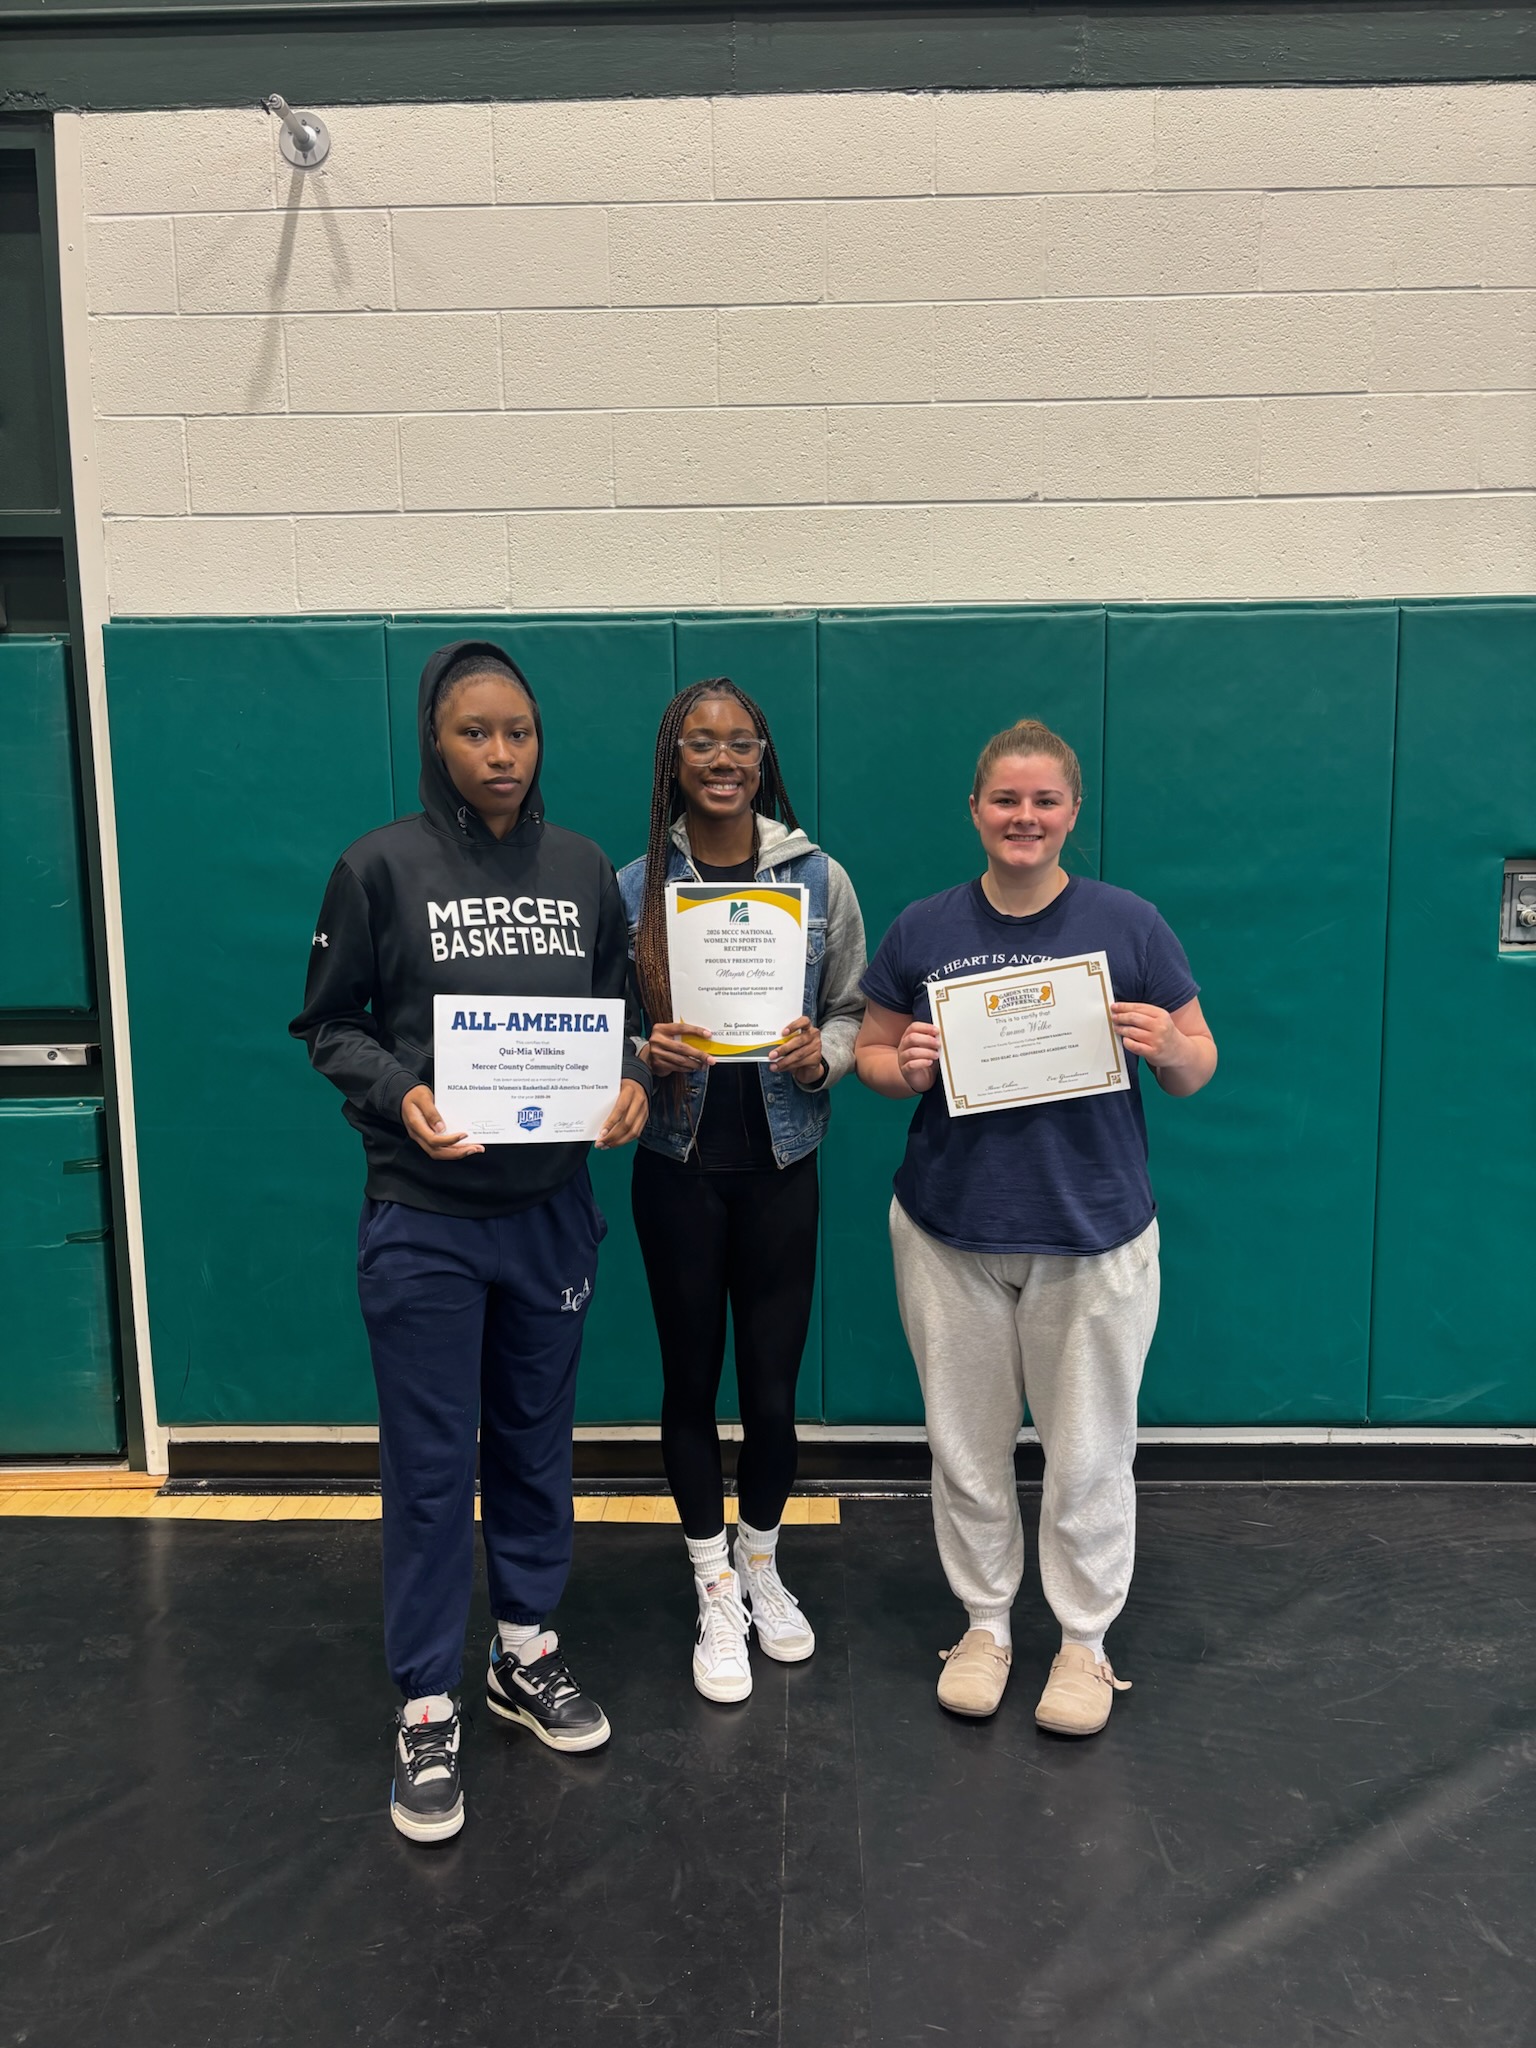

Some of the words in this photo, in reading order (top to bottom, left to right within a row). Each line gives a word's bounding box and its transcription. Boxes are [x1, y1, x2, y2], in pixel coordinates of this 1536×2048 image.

[427, 896, 581, 930] MERCER
[430, 926, 586, 962] BASKETBALL
[943, 954, 989, 974] HEART
[992, 954, 1006, 964] IS
[1008, 954, 1058, 964] ANCH
[998, 989, 1021, 999] GARDEN
[1002, 994, 1034, 1003] ATHLETIC
[997, 999, 1041, 1010] CONFERENCE
[451, 1011, 609, 1032] ALL-AMERICA
[499, 1048, 532, 1056] Qui-Mia
